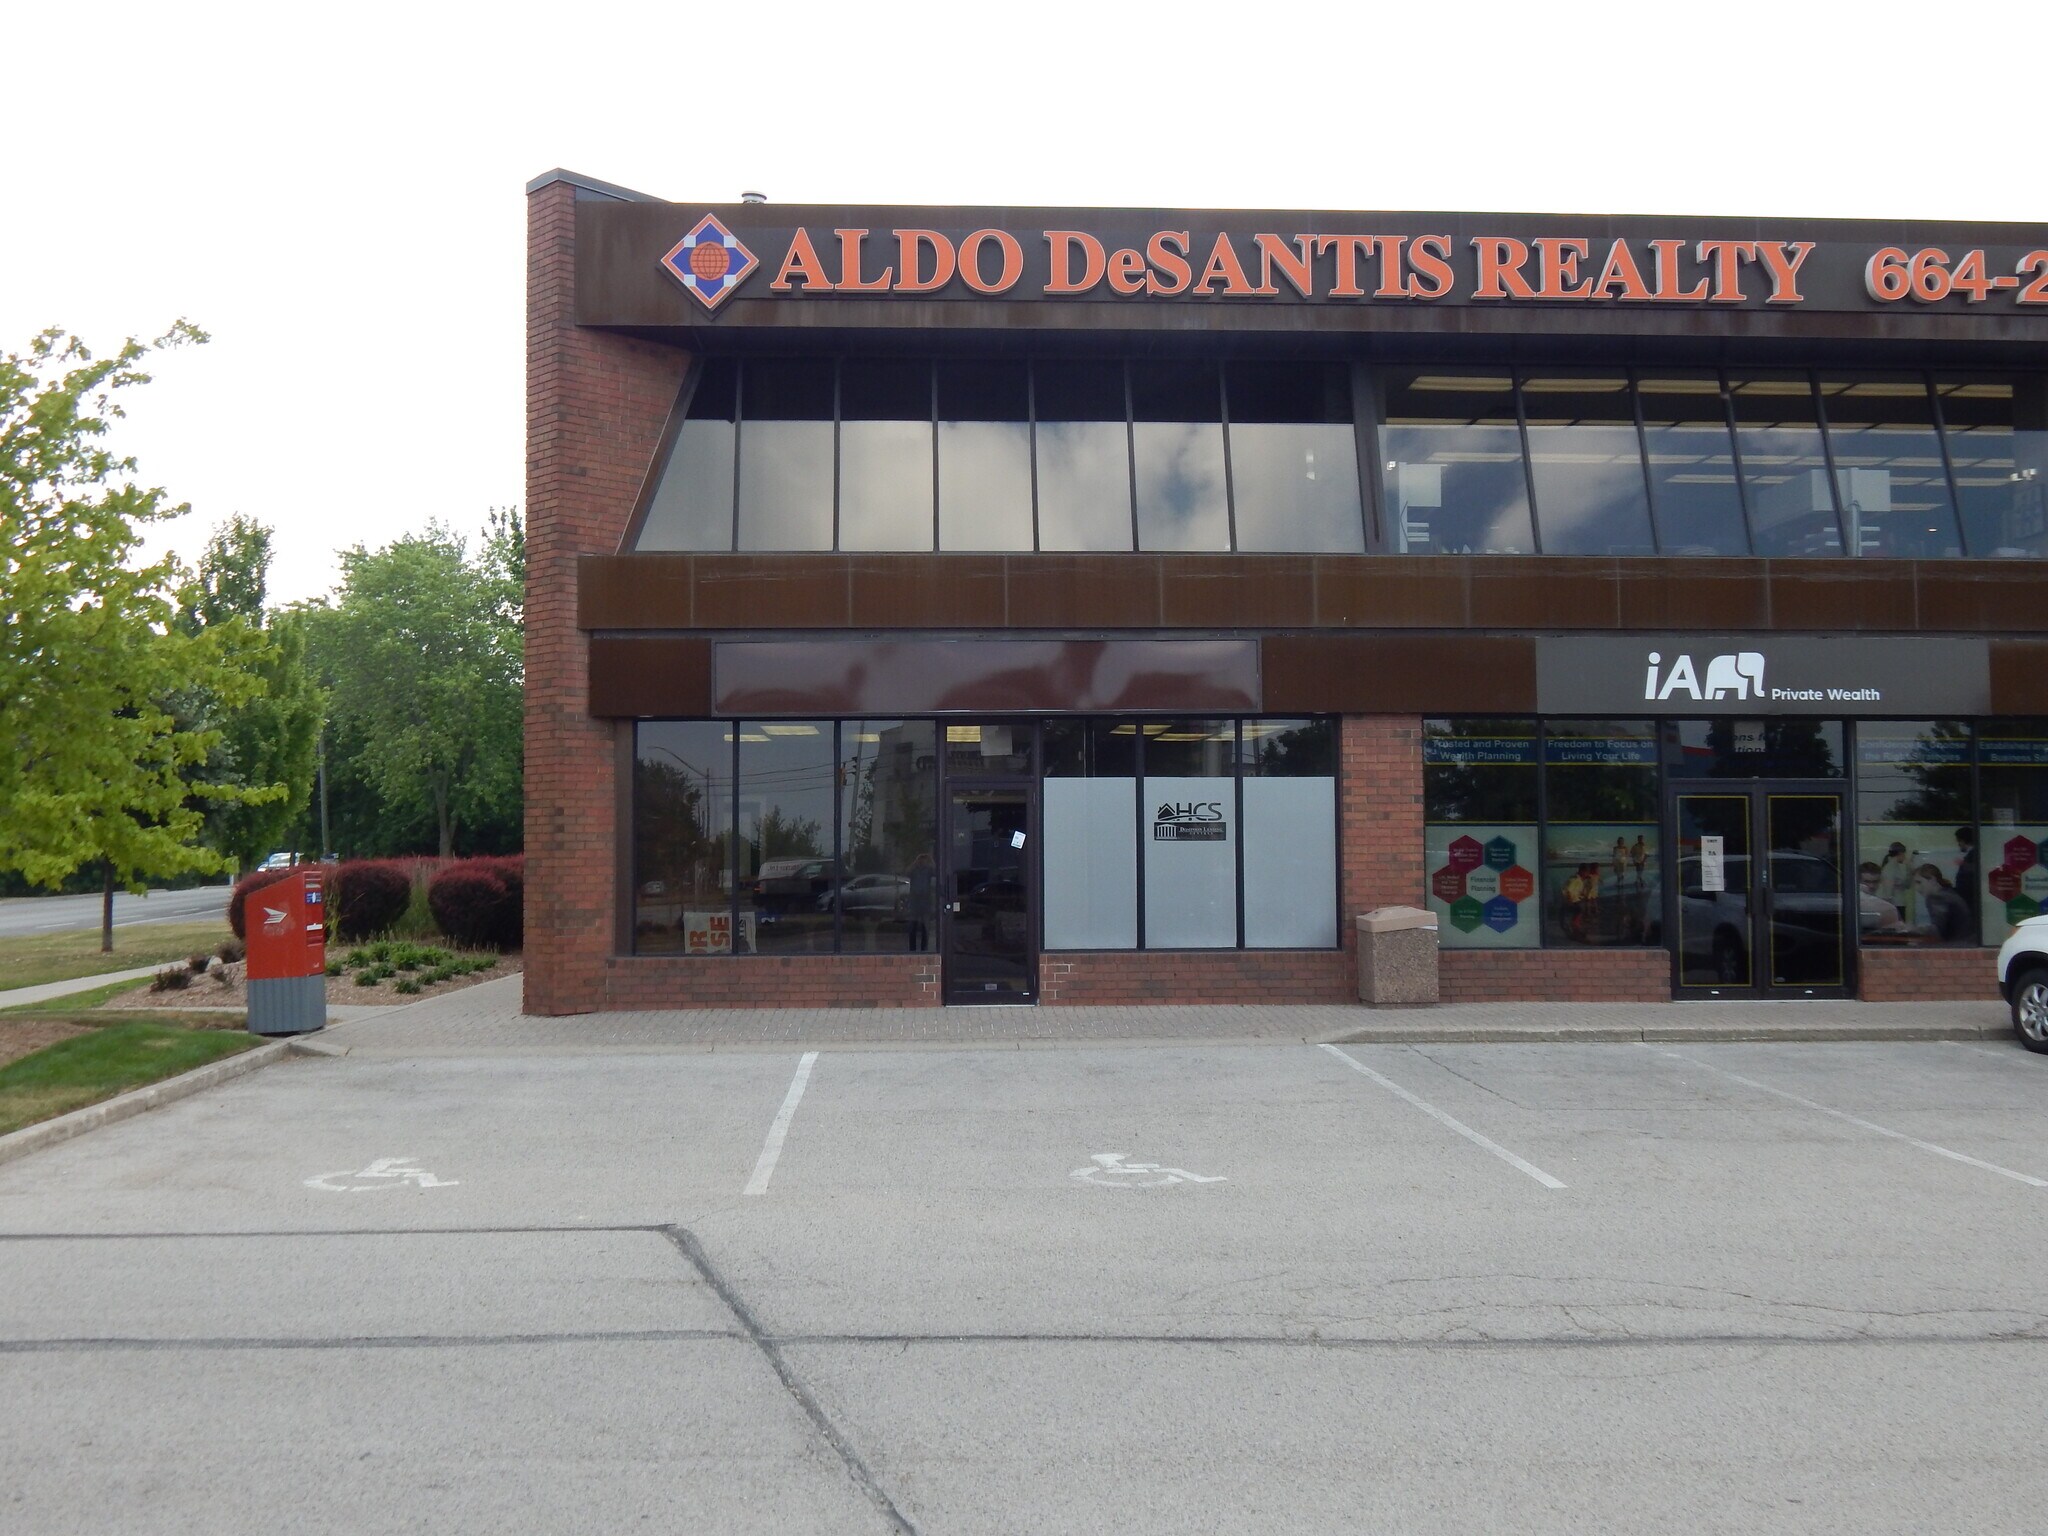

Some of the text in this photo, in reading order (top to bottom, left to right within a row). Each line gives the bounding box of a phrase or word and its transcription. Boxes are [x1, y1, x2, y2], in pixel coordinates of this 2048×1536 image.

[769, 227, 1025, 295] ALDO
[1043, 230, 1455, 299] DeSANTIS
[1471, 236, 1817, 305] REALTY
[1771, 688, 1881, 702] Private Wealth
[1432, 739, 1529, 748] Trusted and Proven
[1548, 740, 1592, 749] Freedom
[1594, 740, 1605, 748] to
[1607, 740, 1639, 749] Focus
[1440, 752, 1521, 762] Wealth Planning
[1561, 752, 1641, 762] Living Your Life
[1176, 803, 1222, 821] HCS
